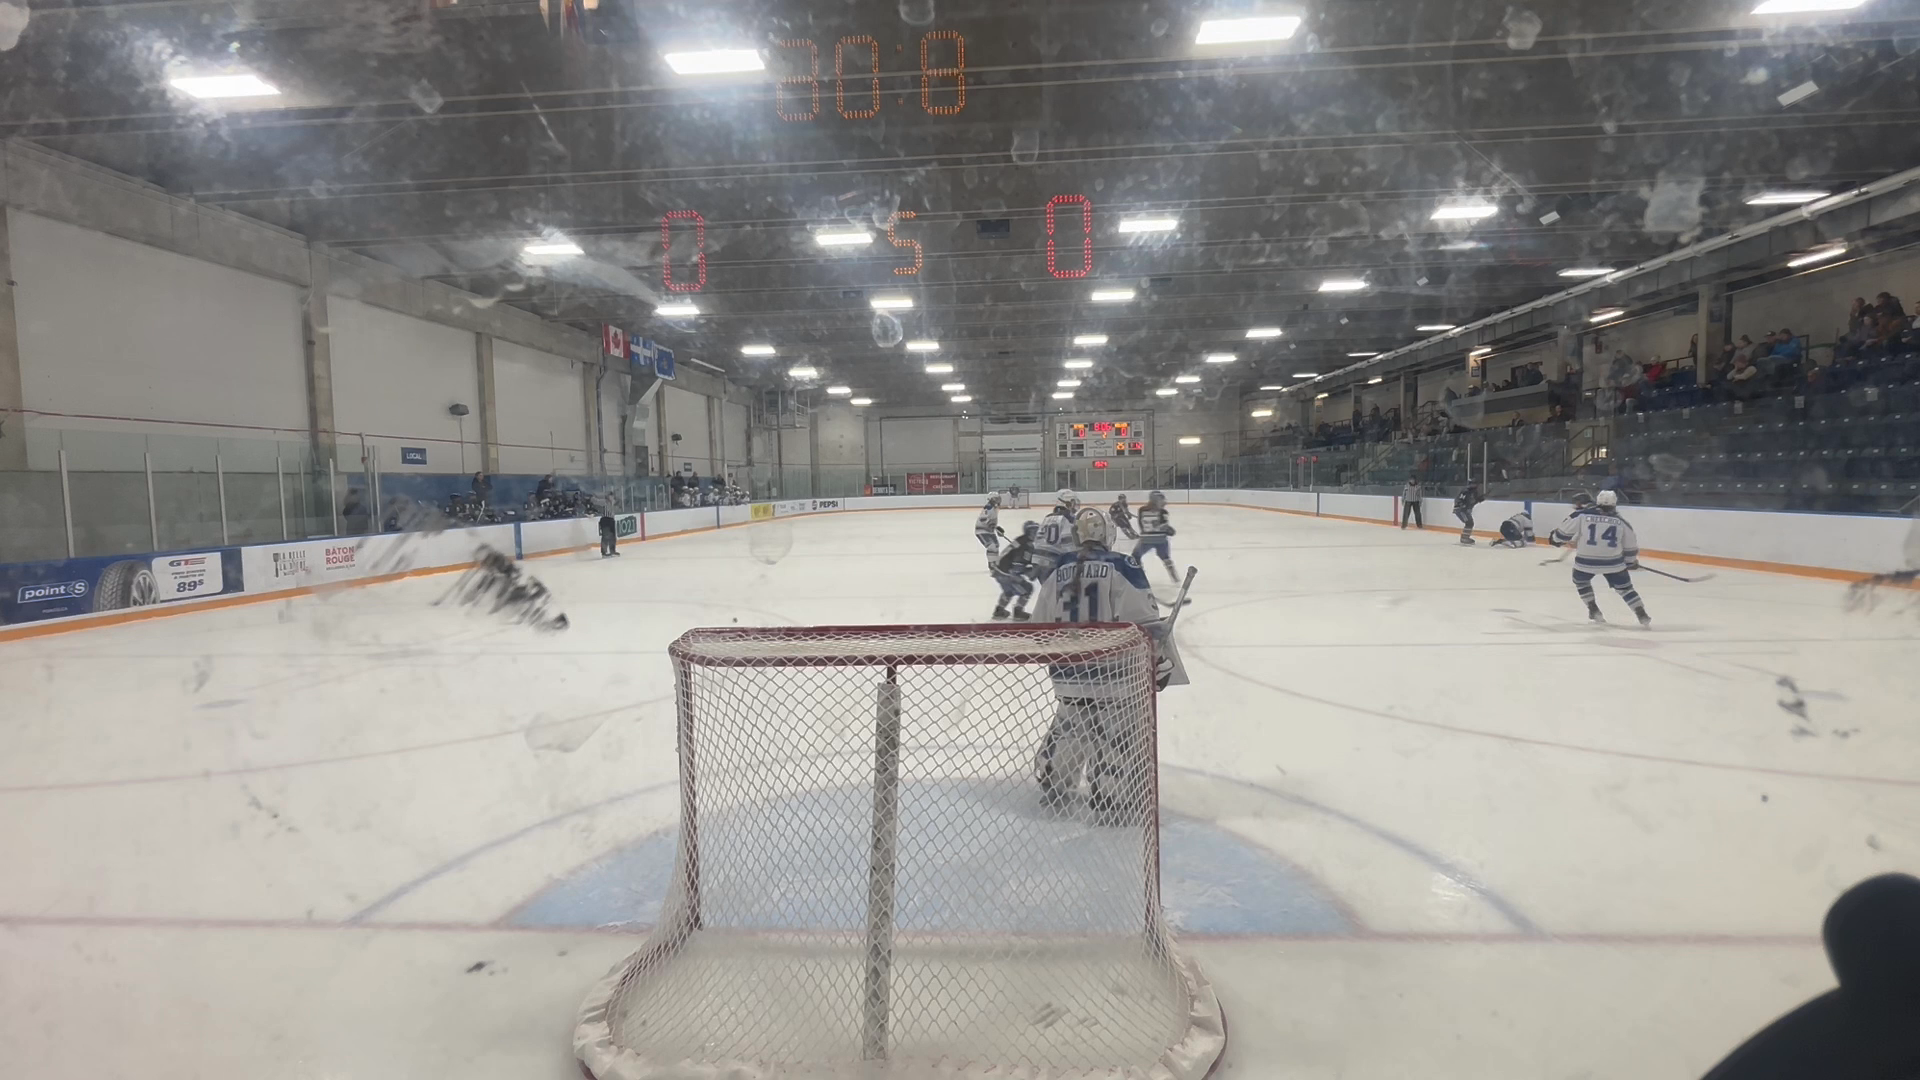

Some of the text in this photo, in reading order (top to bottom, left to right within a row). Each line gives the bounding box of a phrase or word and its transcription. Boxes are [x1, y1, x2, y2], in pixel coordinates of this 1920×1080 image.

[819, 500, 839, 508] PEPSI
[1586, 523, 1618, 548] 14
[326, 554, 355, 565] ROUGE
[25, 585, 67, 600] point
